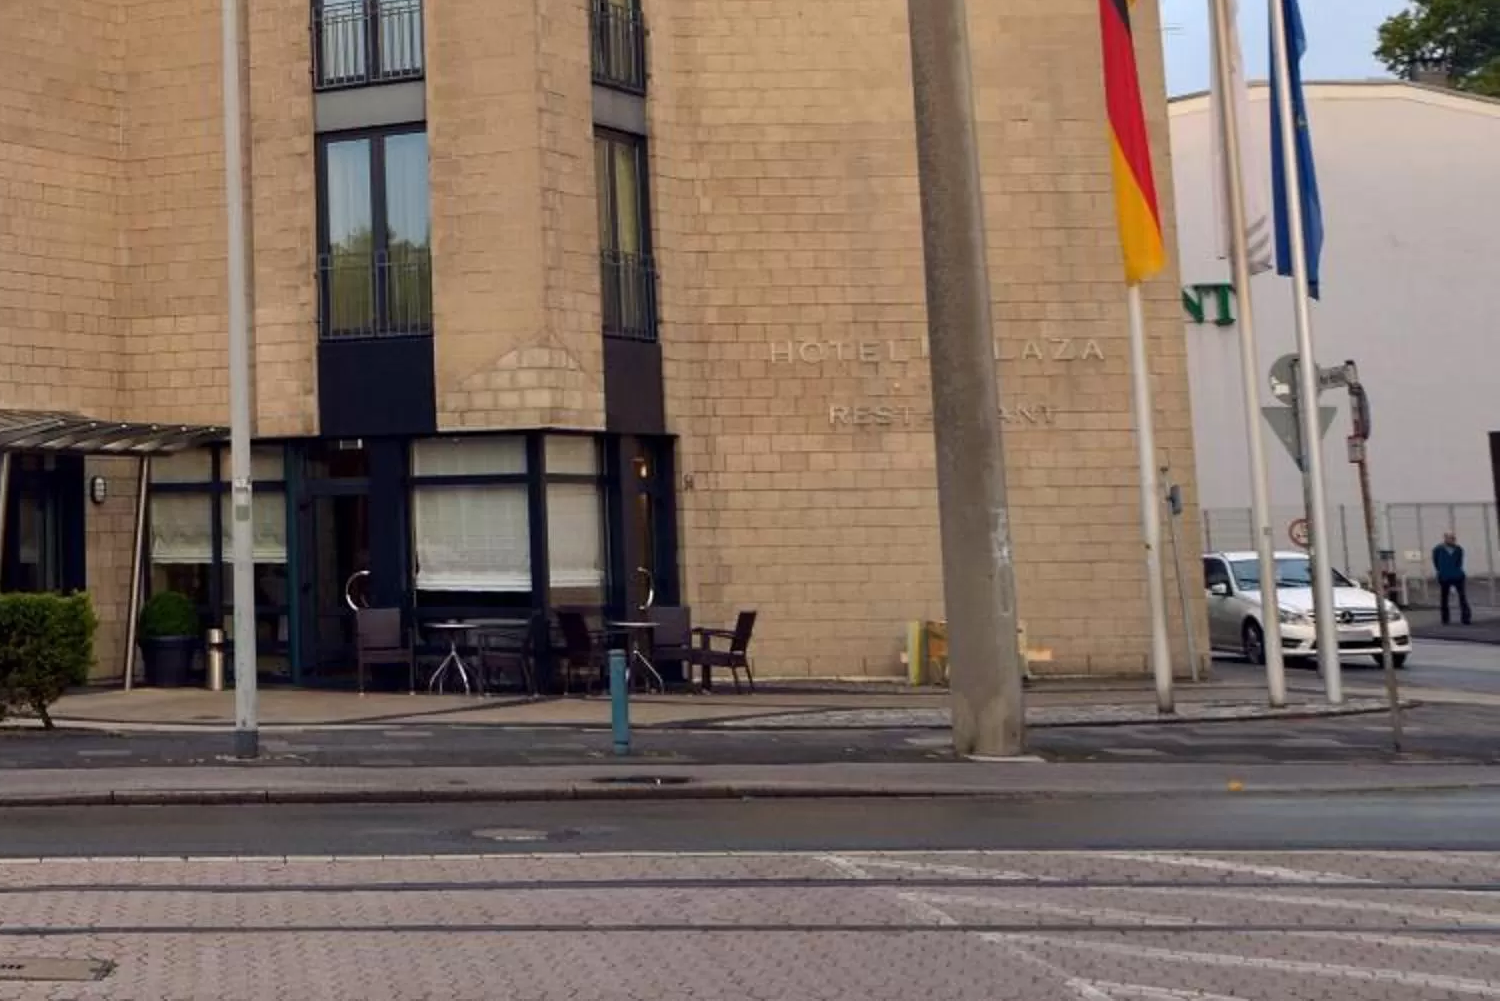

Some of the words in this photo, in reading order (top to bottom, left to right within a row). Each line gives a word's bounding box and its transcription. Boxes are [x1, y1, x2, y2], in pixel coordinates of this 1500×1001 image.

[770, 339, 908, 364] HOTEL
[921, 337, 1105, 361] LAZA
[828, 404, 1059, 426] RESTANT
